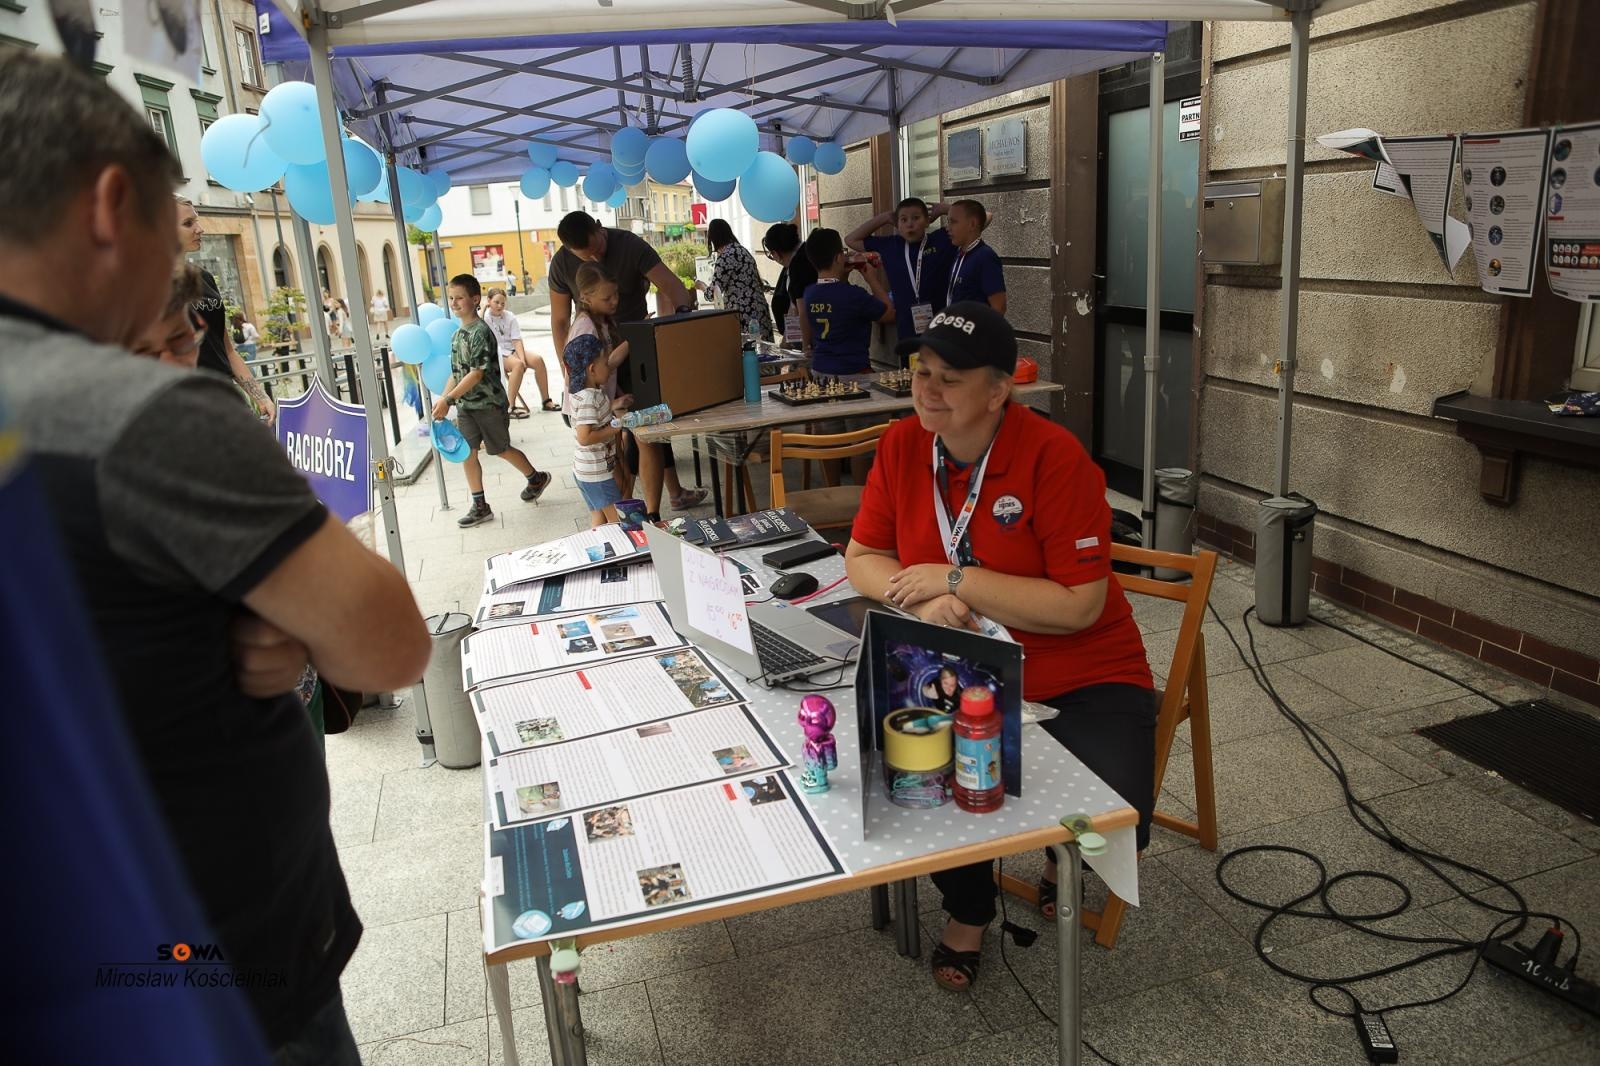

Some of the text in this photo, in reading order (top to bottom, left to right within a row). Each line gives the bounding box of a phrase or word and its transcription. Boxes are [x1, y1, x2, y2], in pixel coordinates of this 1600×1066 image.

[809, 303, 832, 313] ZSP 2
[815, 318, 830, 339] 7
[286, 428, 355, 481] RACIBÓRZ
[949, 526, 964, 549] SOWA
